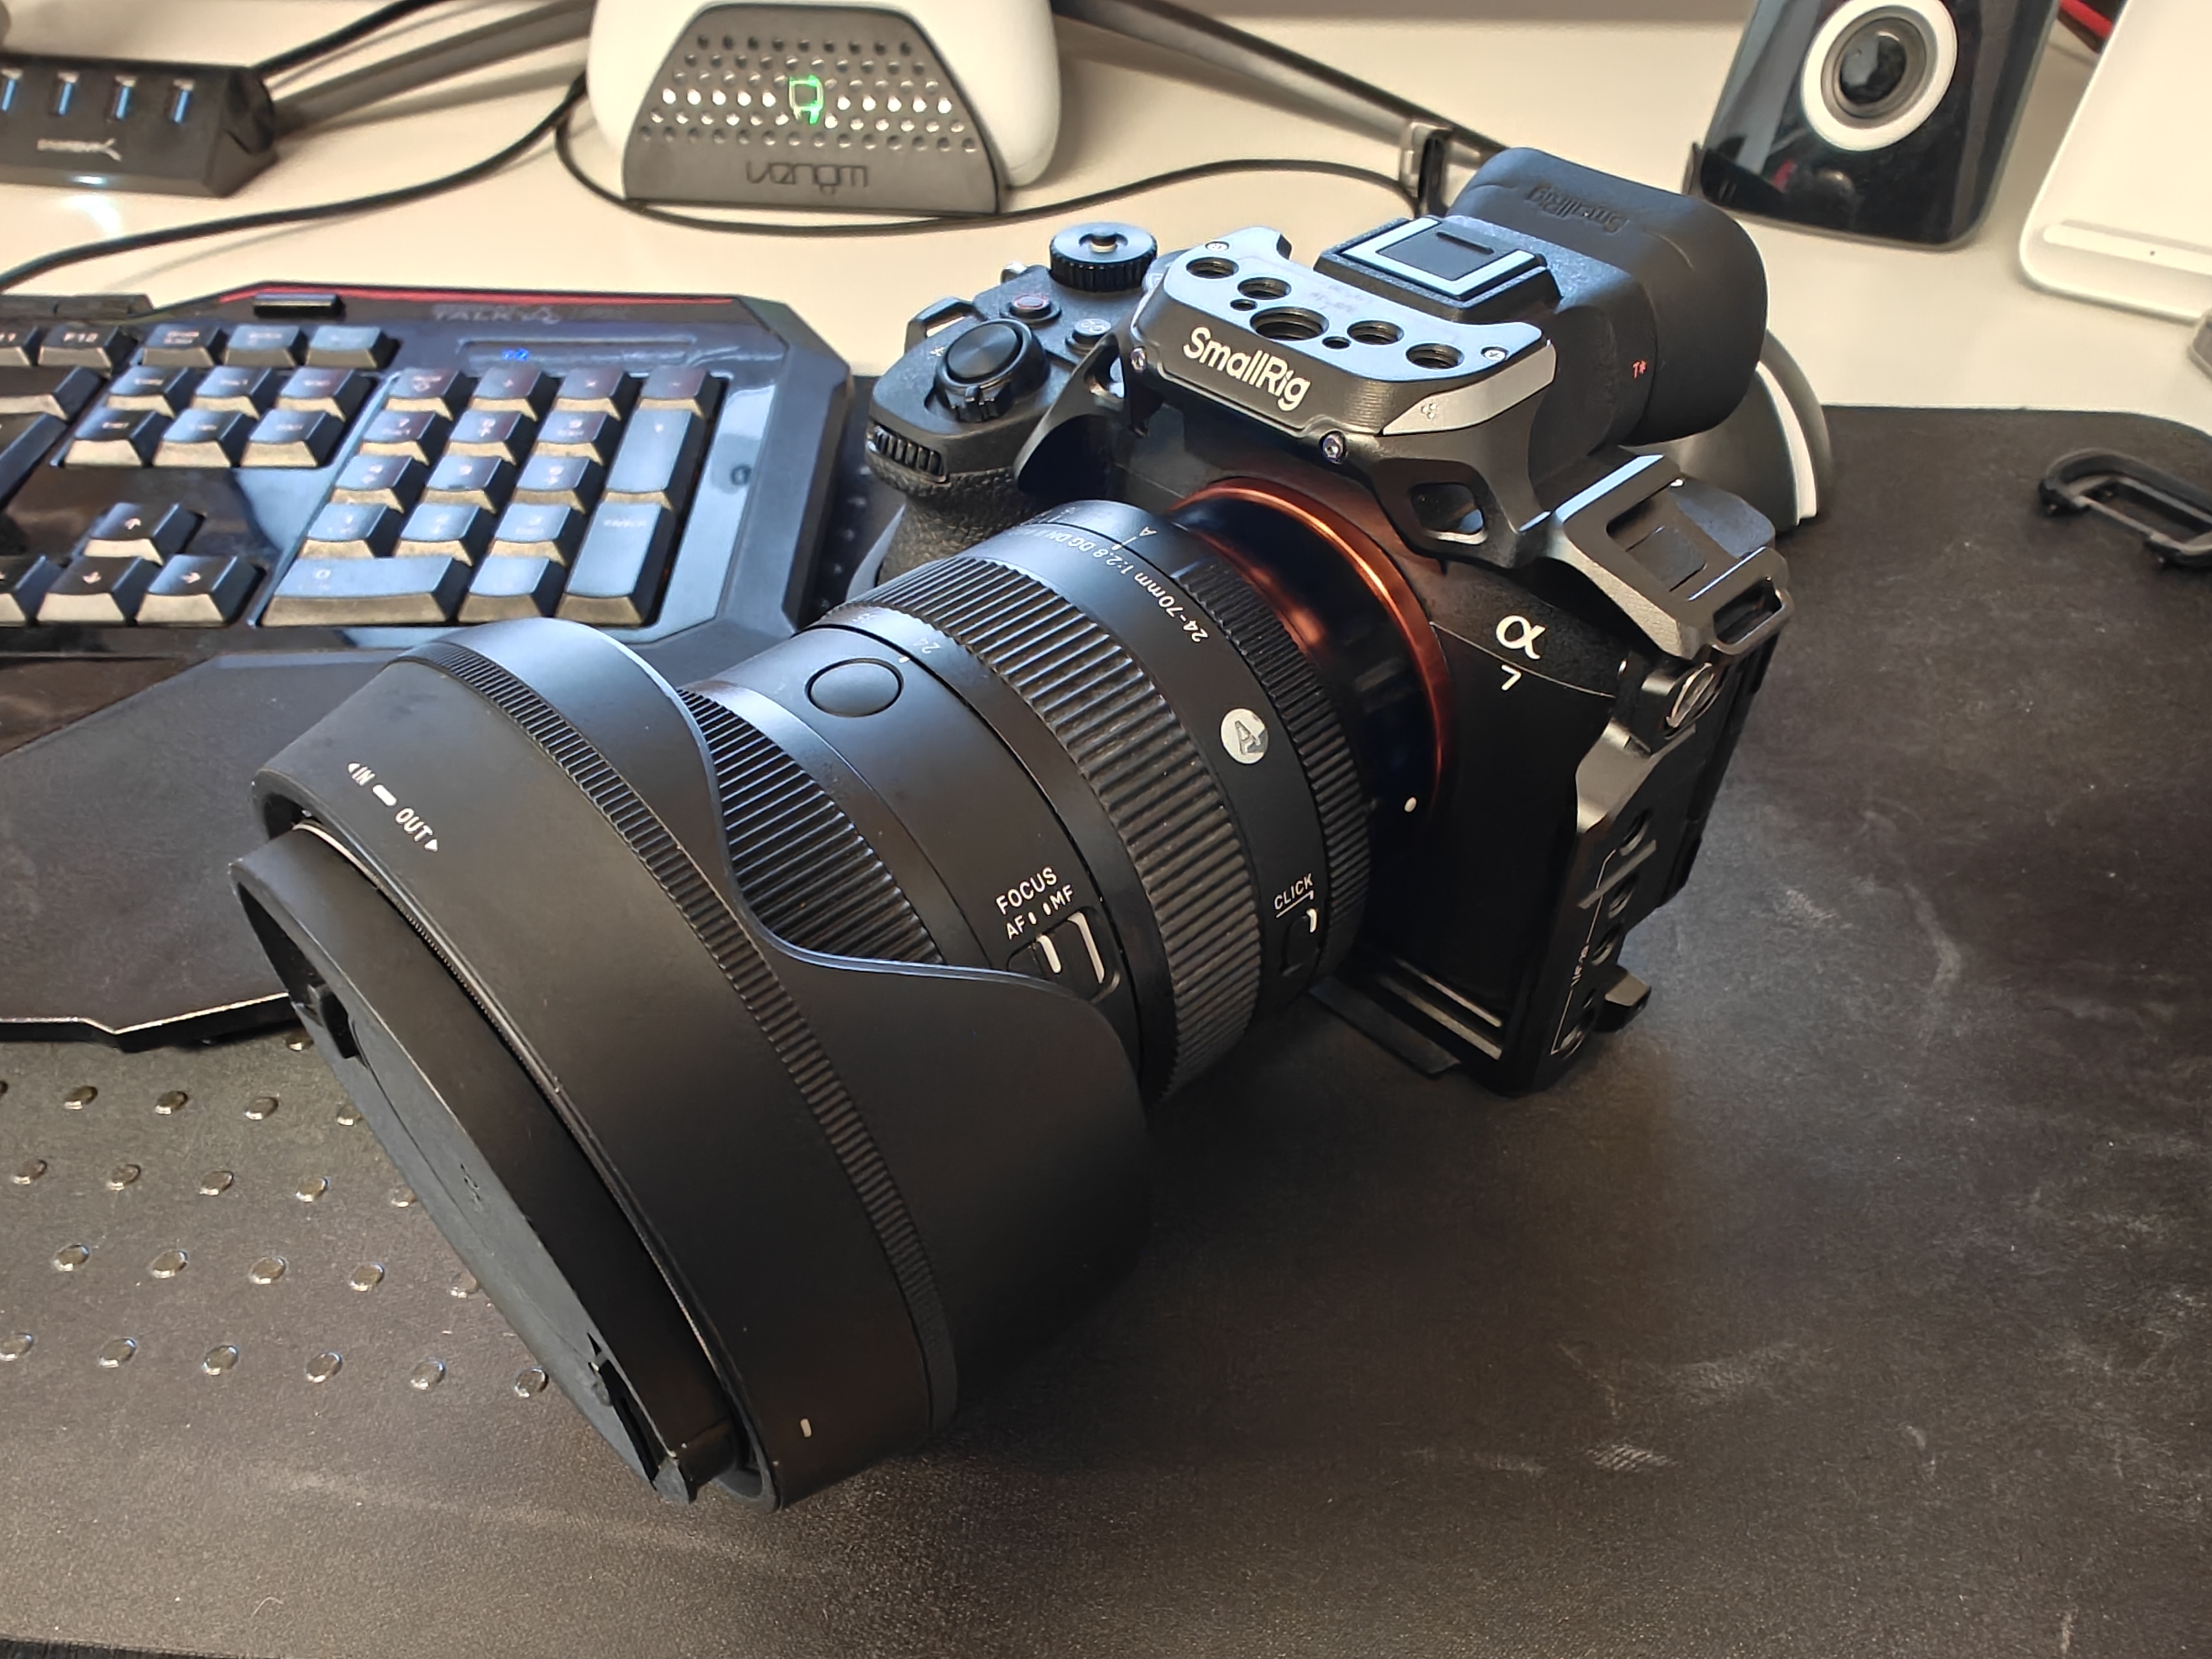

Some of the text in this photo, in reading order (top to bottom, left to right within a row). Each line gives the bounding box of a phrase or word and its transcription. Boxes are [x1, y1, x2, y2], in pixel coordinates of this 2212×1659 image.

[1183, 326, 1311, 411] SmallRig
[1139, 526, 1157, 536] A
[1092, 549, 1134, 575] 1:2.8
[1134, 572, 1209, 643] 24-70mm
[1501, 664, 1522, 691] 7
[351, 766, 376, 786] IN
[395, 807, 434, 842] OUT
[996, 867, 1057, 915] FOCUS
[1274, 873, 1313, 910] CLICK
[1006, 884, 1073, 940] AF MF
